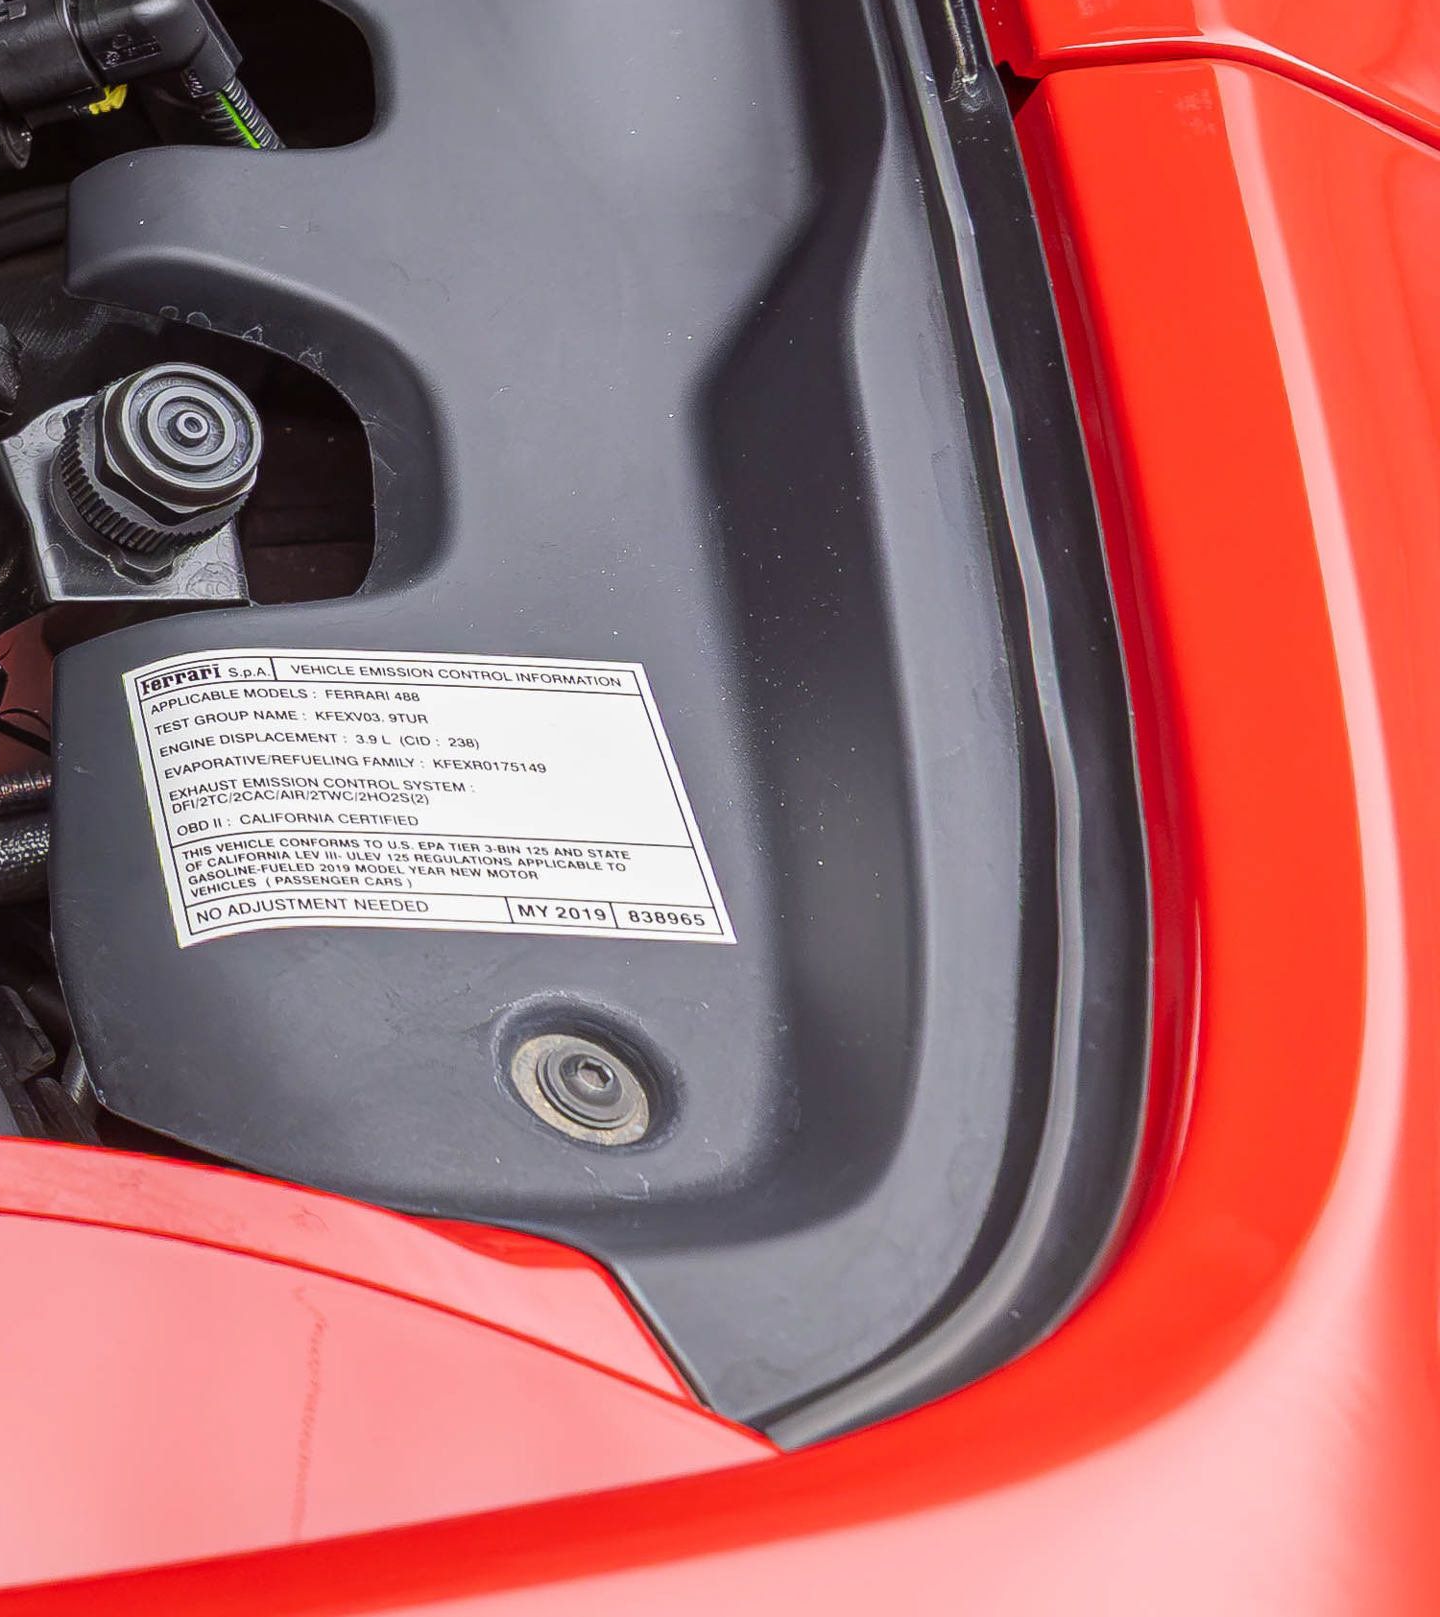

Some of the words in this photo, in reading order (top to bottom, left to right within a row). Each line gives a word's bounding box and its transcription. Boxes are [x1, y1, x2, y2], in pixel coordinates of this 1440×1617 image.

[142, 664, 221, 695] Ferrari
[229, 667, 270, 679] S.p.A.
[291, 665, 355, 676] VEHICLE
[360, 667, 433, 678] EMISSION
[439, 669, 512, 682] CONTROL
[517, 673, 621, 687] INFORMATION
[151, 689, 239, 715] APPLICABLE
[244, 688, 308, 698] MODELS
[325, 690, 389, 700] FERRARI
[395, 693, 420, 702] 488
[155, 718, 189, 735] TEST
[195, 711, 249, 725] GROUP
[254, 711, 297, 720] NAME
[389, 713, 428, 723] 9TUR
[160, 737, 215, 757] ENGINE
[220, 733, 337, 745] DISPLACEMENT
[356, 735, 376, 744] 3.9
[382, 735, 390, 745] L
[400, 736, 430, 747] (CID
[448, 738, 479, 749] 238)
[165, 755, 358, 779] EVAPORATIVE/REFUELING
[363, 757, 415, 767] FAMILY
[433, 759, 546, 773] KFEXR0175149
[170, 779, 237, 801] EXHAUST
[243, 778, 318, 789] EMISSION
[323, 778, 398, 790] CONTROL
[403, 781, 466, 792] SYSTEM
[177, 820, 209, 836] OBD
[214, 818, 222, 829] II
[240, 813, 334, 825] CALIFORNIA
[338, 814, 419, 826] CERTIFIED
[182, 847, 212, 860] THIS
[216, 839, 275, 852] VEHICLE
[279, 838, 360, 848] CONFORMS
[364, 840, 383, 849] TO
[388, 841, 414, 849] U.S.
[419, 842, 445, 851] EPA
[449, 843, 480, 852] TIER
[485, 844, 521, 854] 3-BIN
[527, 846, 549, 855] 125
[554, 847, 583, 857] AND
[588, 849, 631, 860] STATE
[185, 862, 202, 873] OF
[207, 851, 290, 868] CALIFORNIA
[295, 851, 321, 859] LEV
[347, 852, 381, 861] ULEV
[387, 853, 409, 862] 125
[414, 854, 514, 866] REGULATIONS
[517, 858, 603, 871] APPLICABLE
[608, 862, 626, 872] TO
[188, 864, 315, 886] GASOLINE-FUELED
[320, 864, 350, 873] 2019
[356, 865, 404, 874] MODEL
[408, 865, 446, 876] YEAR
[450, 867, 481, 878] NEW
[487, 869, 539, 880] MOTOR
[191, 879, 256, 897] VEHICLES
[275, 876, 360, 885] PASSENGER
[364, 877, 402, 887] CARS
[197, 908, 222, 924] NO
[228, 898, 348, 917] ADJUSTMENT
[353, 898, 429, 912] NEEDED
[518, 904, 549, 917] MY
[556, 906, 607, 921] 2019
[629, 910, 705, 926] 838965
